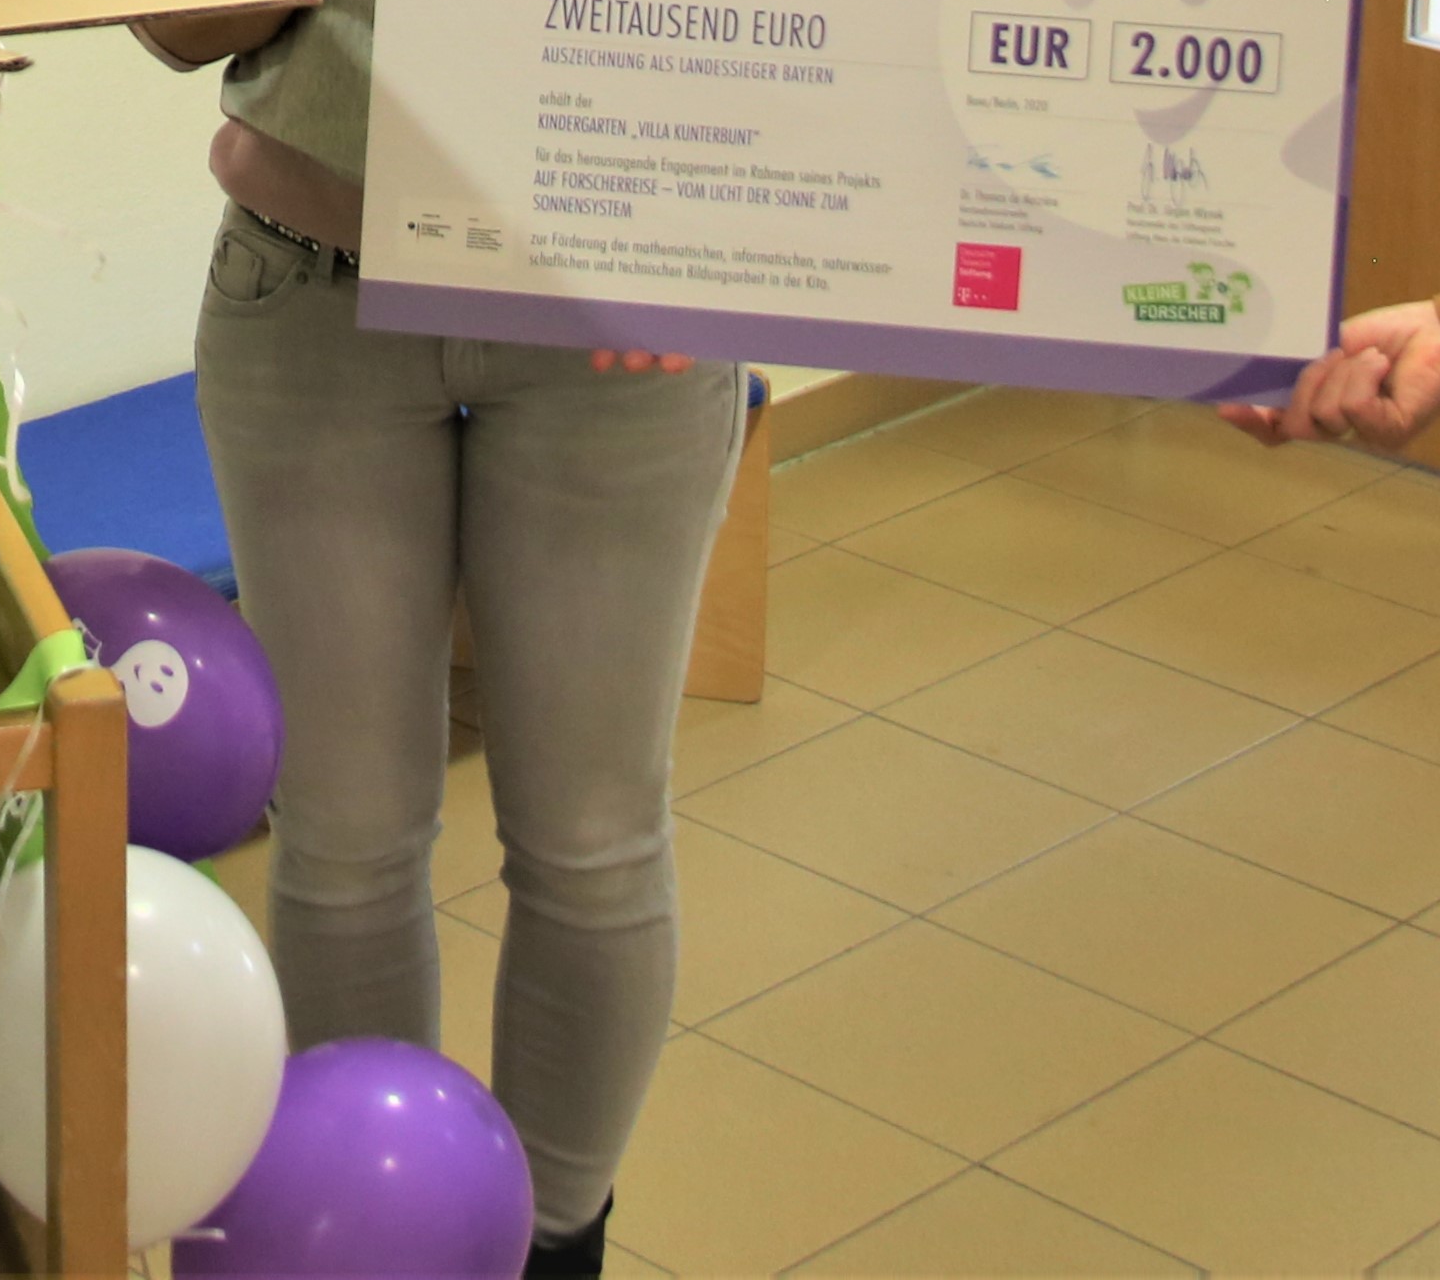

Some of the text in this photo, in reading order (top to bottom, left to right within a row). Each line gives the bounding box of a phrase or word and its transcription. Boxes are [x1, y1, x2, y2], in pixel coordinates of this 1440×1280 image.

[752, 9, 827, 49] EURO
[542, 46, 834, 84] AUSZEICHNUNG ALS LANDESSIEGER BAYERN
[990, 22, 1263, 84] EUR 2.000
[539, 91, 592, 108] erhält der
[1024, 98, 1048, 111] 2020
[538, 113, 627, 135] KINDERGARTEN
[631, 121, 669, 139] „VILLA
[536, 146, 881, 190] für das herausragende Engagement im Rahmen seines Projekts
[533, 194, 632, 218] SONNENSYSTEM
[534, 170, 849, 210] AUF FORSCHERREISE VOM LICHT DER SONNE ZUM
[531, 232, 893, 274] zur Förderung der mathematischen, informatischen, naturwissen-
[594, 258, 614, 272] und
[619, 260, 682, 278] technischen
[687, 264, 765, 285] Bildungsarbeit
[769, 273, 779, 285] in
[784, 272, 800, 287] der
[806, 275, 830, 290] Kita.
[1126, 287, 1180, 302] KLEINE
[1138, 305, 1219, 320] FORSCHER
